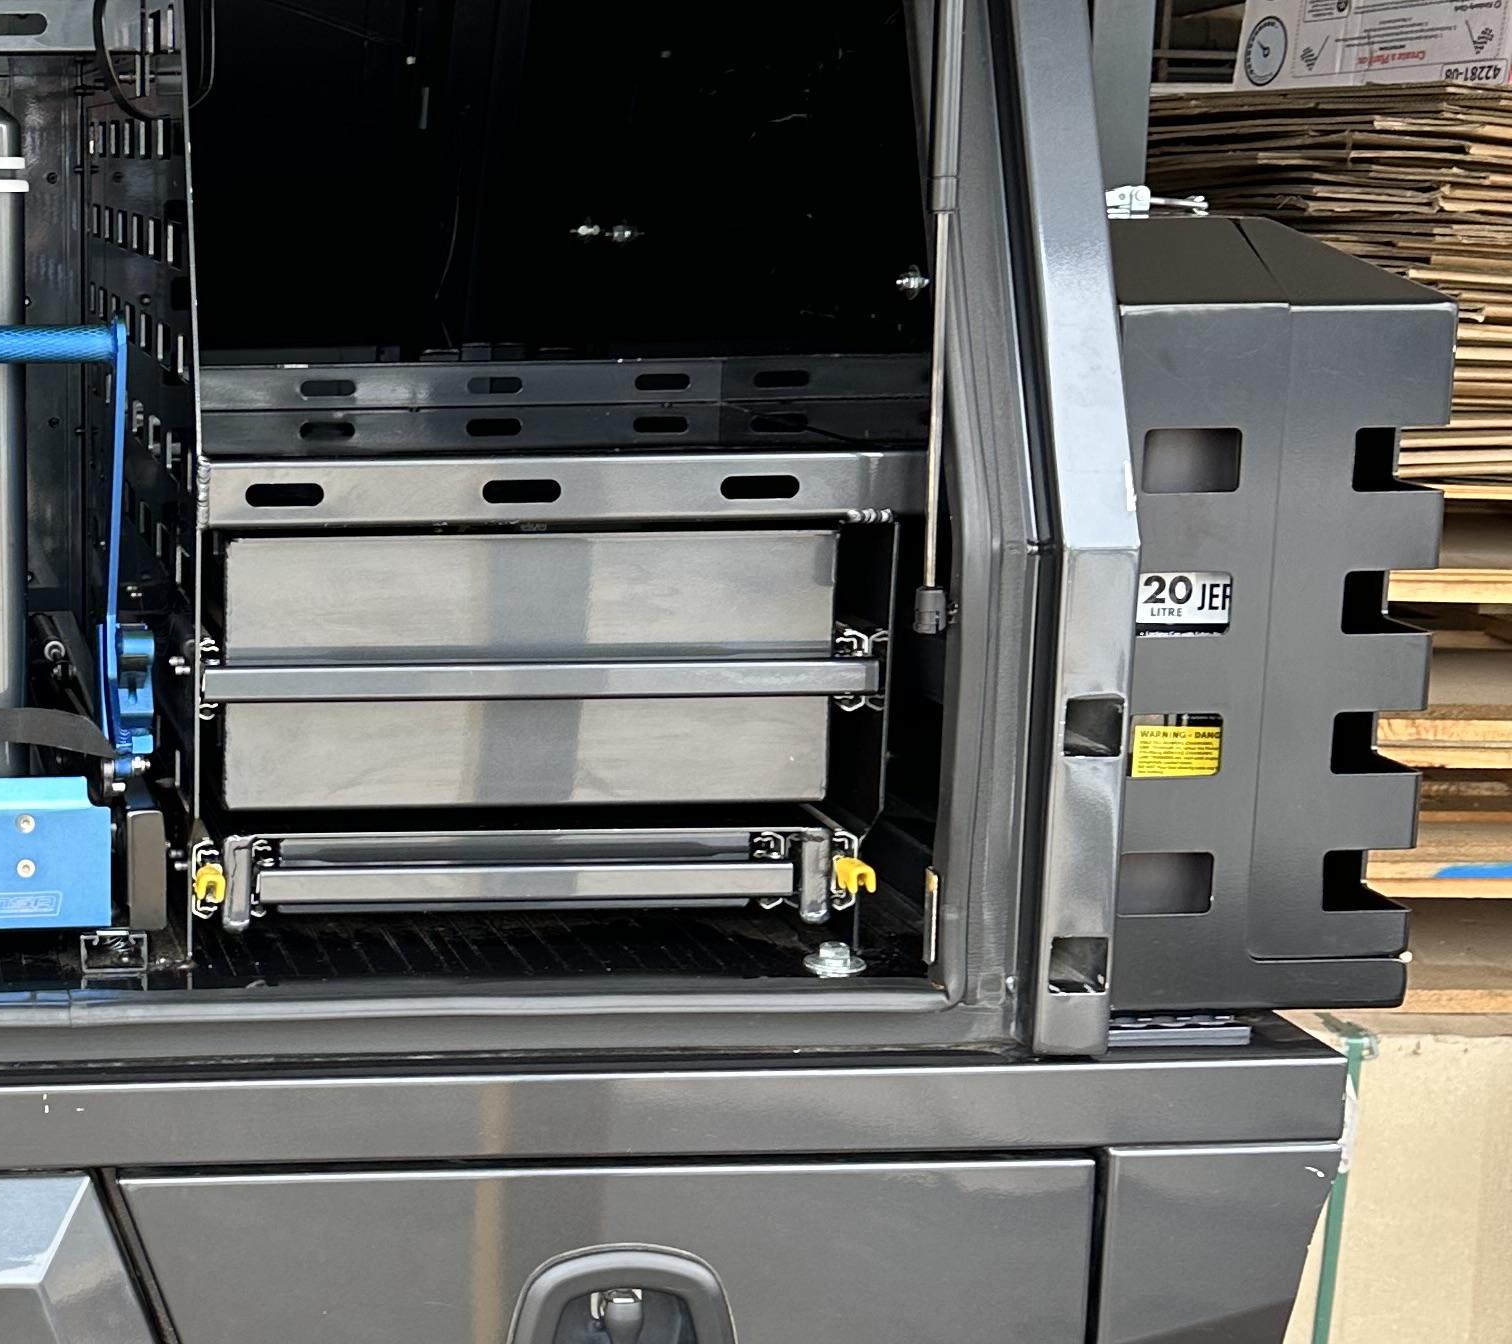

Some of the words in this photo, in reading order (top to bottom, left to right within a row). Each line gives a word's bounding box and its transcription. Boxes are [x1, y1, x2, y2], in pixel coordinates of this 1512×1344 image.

[1142, 575, 1193, 605] 20
[1150, 607, 1183, 617] LITRE
[1140, 730, 1187, 738] WARNING
